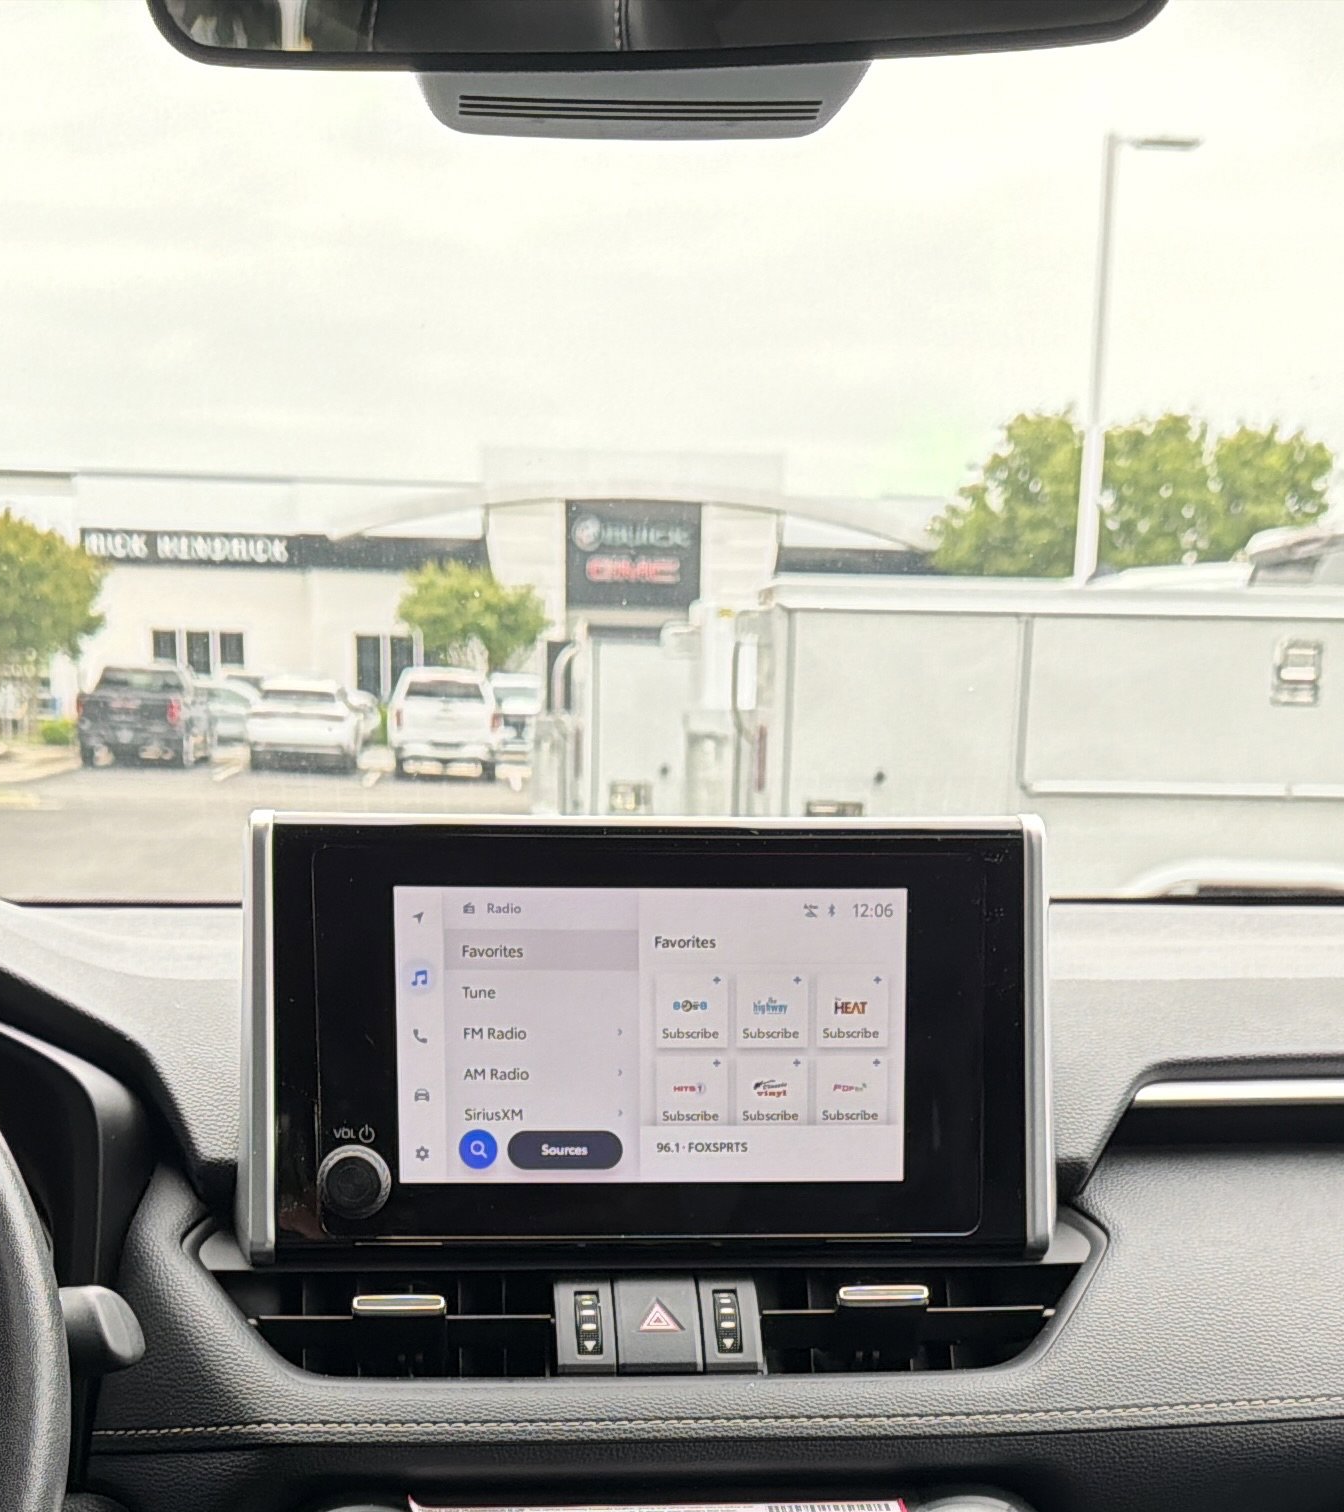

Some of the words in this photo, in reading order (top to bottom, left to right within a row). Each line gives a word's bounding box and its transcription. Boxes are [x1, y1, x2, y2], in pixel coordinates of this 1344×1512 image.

[487, 903, 521, 914] Radio
[852, 903, 893, 917] 12:06
[655, 936, 716, 949] Favorites
[462, 945, 523, 958] Favorites
[462, 986, 496, 999] Tune
[834, 1001, 868, 1015] HEAT
[463, 1028, 484, 1040] FM
[488, 1027, 527, 1040] Radio
[662, 1028, 719, 1040] Subscribe
[742, 1028, 800, 1040] Subscribe
[822, 1028, 879, 1040] Subscribe
[464, 1068, 486, 1081] AM
[490, 1068, 529, 1081] Radio
[464, 1108, 523, 1121] SiriusXM
[662, 1111, 719, 1122] Subscribe
[742, 1111, 799, 1122] Subscribe
[822, 1111, 878, 1122] Subscribe
[333, 1128, 356, 1139] VOL
[541, 1143, 588, 1156] Sources
[656, 1142, 680, 1153] 96.1
[688, 1142, 748, 1153] FOXSPRTS
